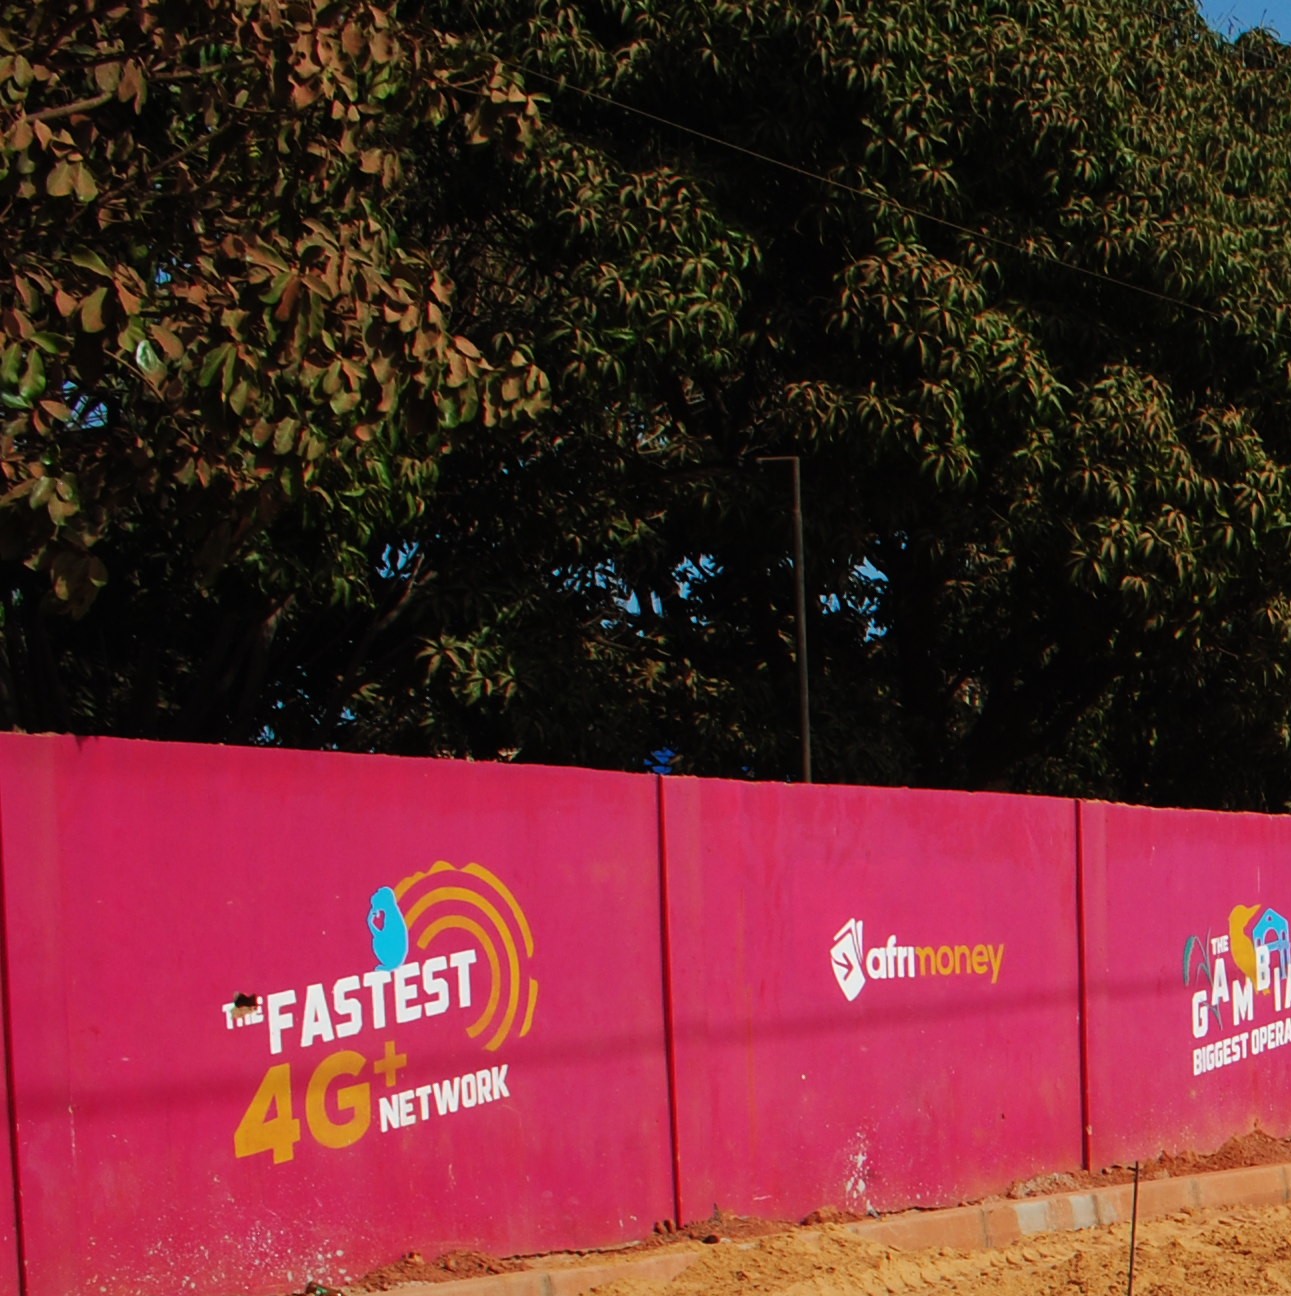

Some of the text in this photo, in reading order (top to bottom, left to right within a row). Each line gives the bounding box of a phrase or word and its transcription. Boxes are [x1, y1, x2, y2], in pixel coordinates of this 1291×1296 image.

[866, 934, 1005, 984] afrimoney
[1210, 934, 1230, 956] THE
[266, 949, 478, 1055] FASTEST
[1193, 1031, 1249, 1077] BIGGEST
[233, 1040, 510, 1164] 4G+ NETWORK
